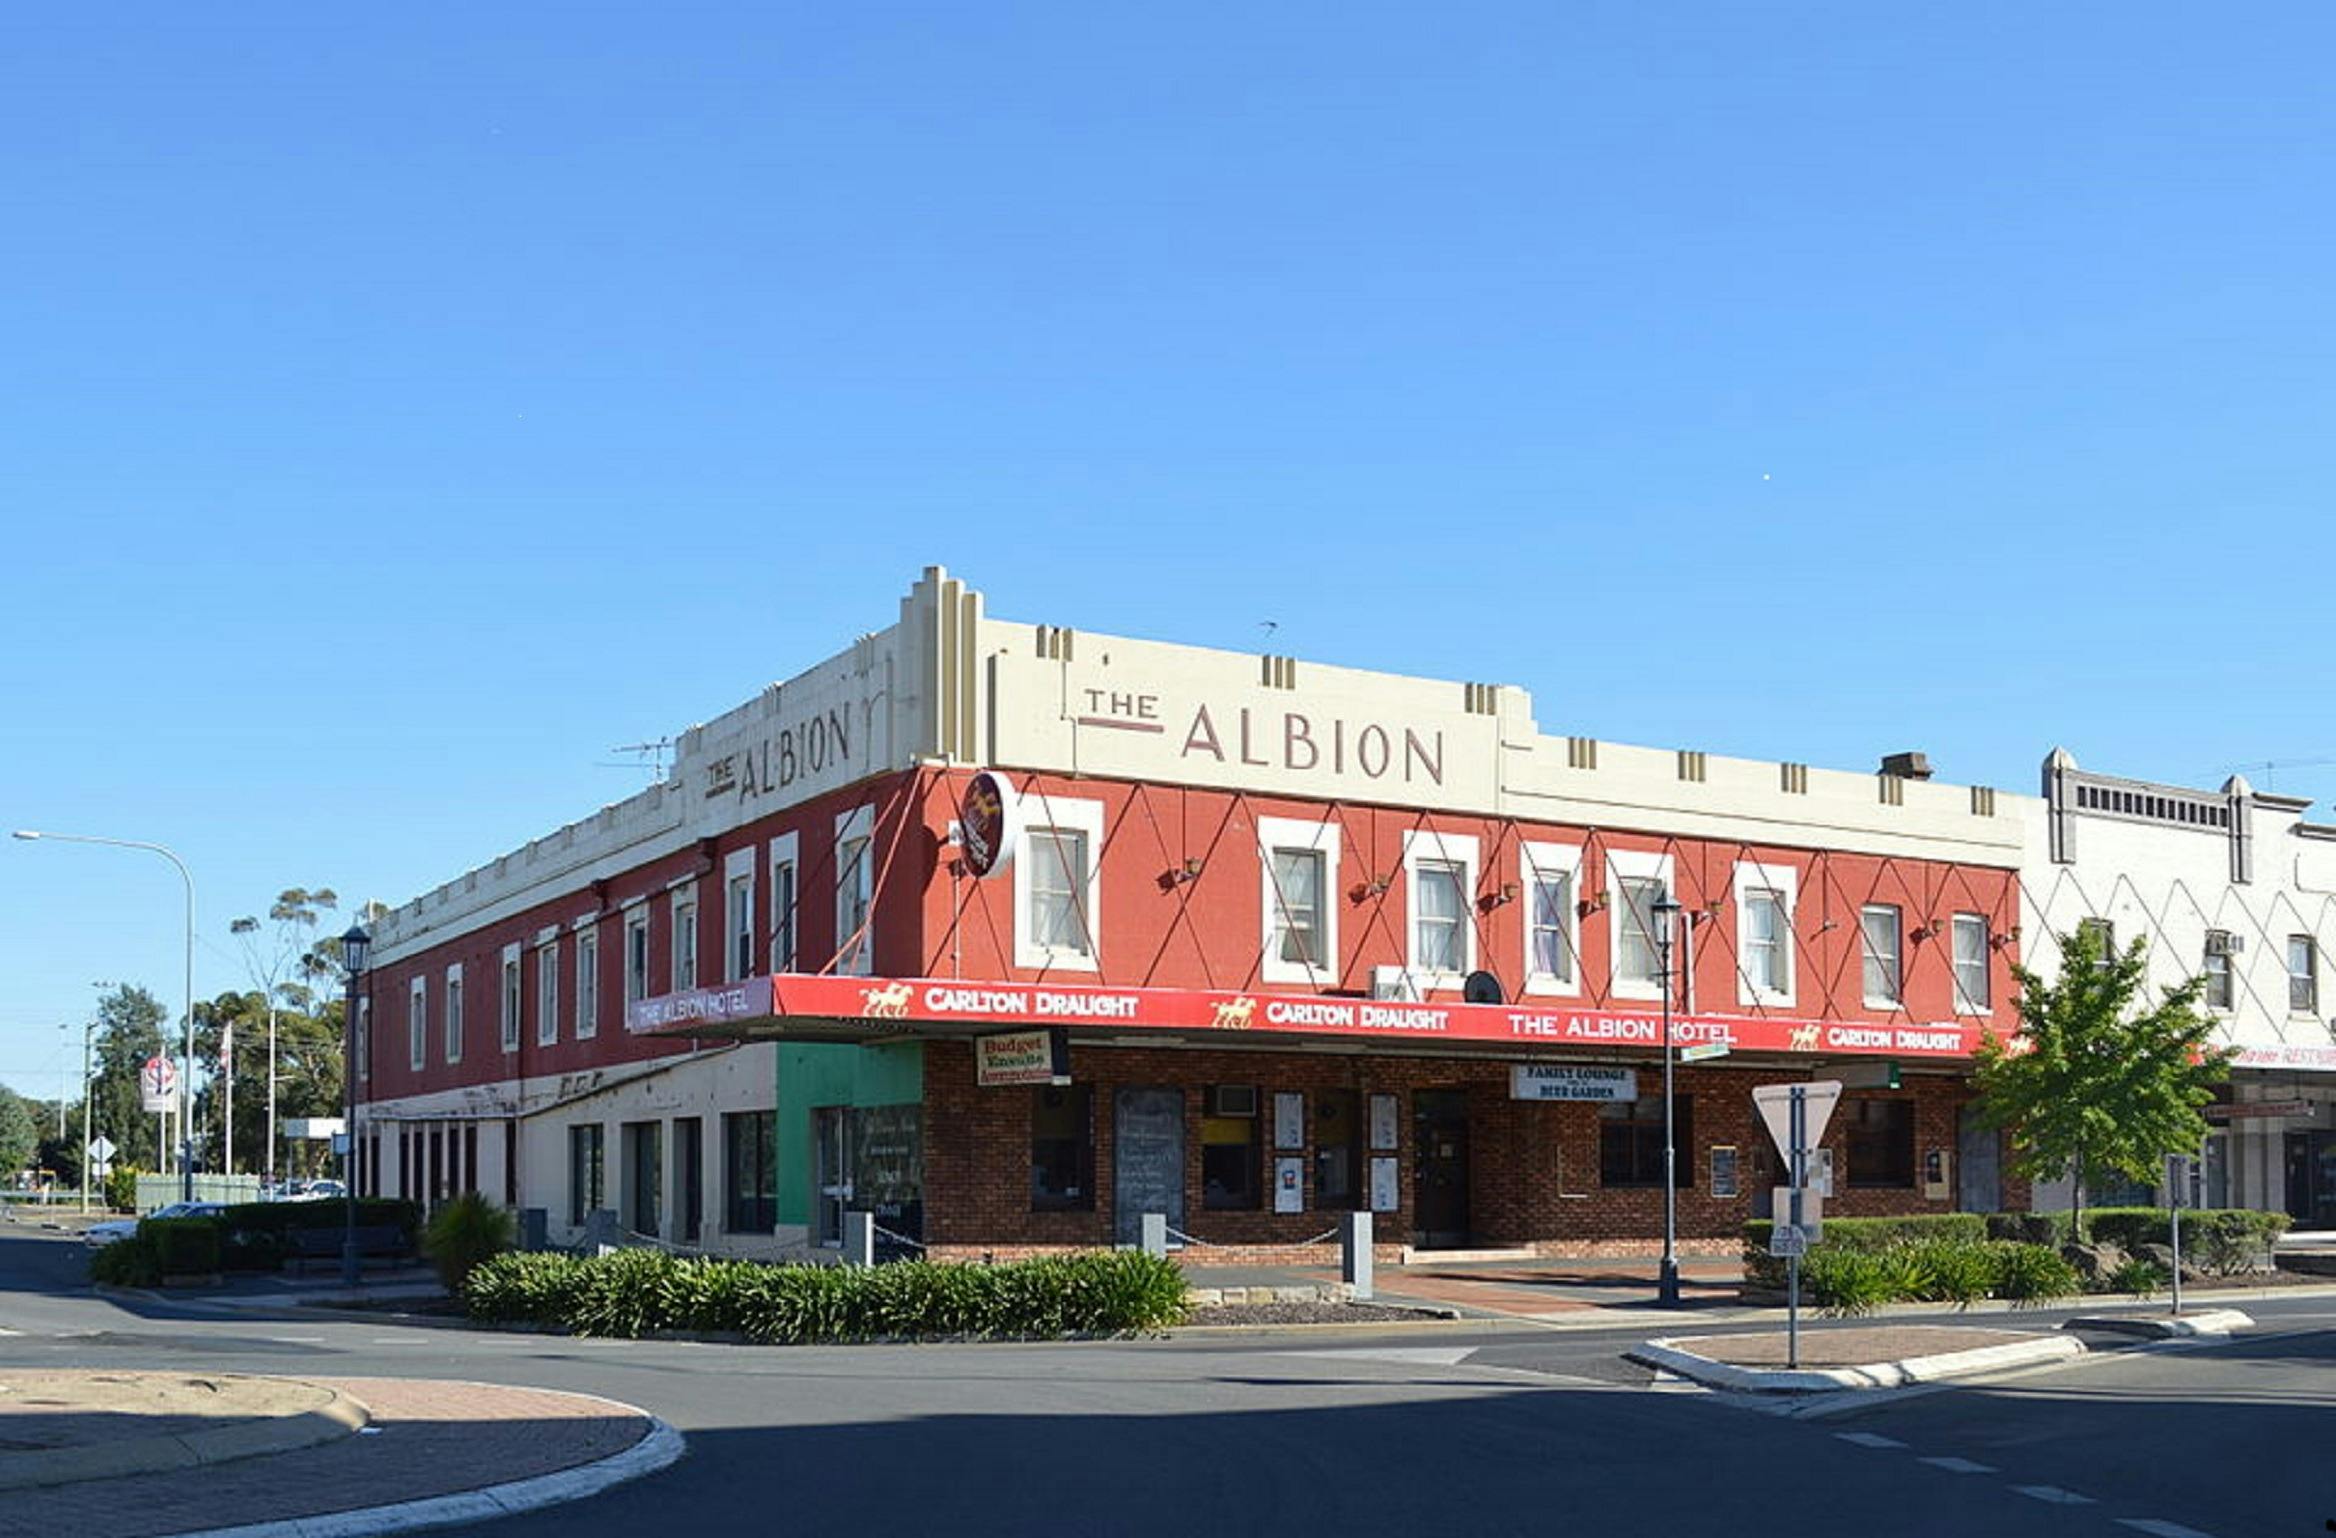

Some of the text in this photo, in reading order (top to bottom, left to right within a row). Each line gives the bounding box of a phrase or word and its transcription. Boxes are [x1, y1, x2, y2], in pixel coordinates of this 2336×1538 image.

[1085, 687, 1443, 786] THE ALBION
[708, 700, 850, 806] THE ALBION
[707, 989, 749, 1017] HOTEL
[925, 987, 1139, 1018] CARLTON DRAUGHT
[1266, 1001, 1449, 1031] CARLTON DRAUGHT
[1508, 1013, 1738, 1044] THE ALBION HOTEL
[1828, 1027, 1963, 1051] CARLTON DRAUGHT
[985, 1037, 1045, 1056] Budget
[1527, 1065, 1626, 1081] FAMILY LOUNGE
[1540, 1084, 1616, 1099] BEER GARDEN
